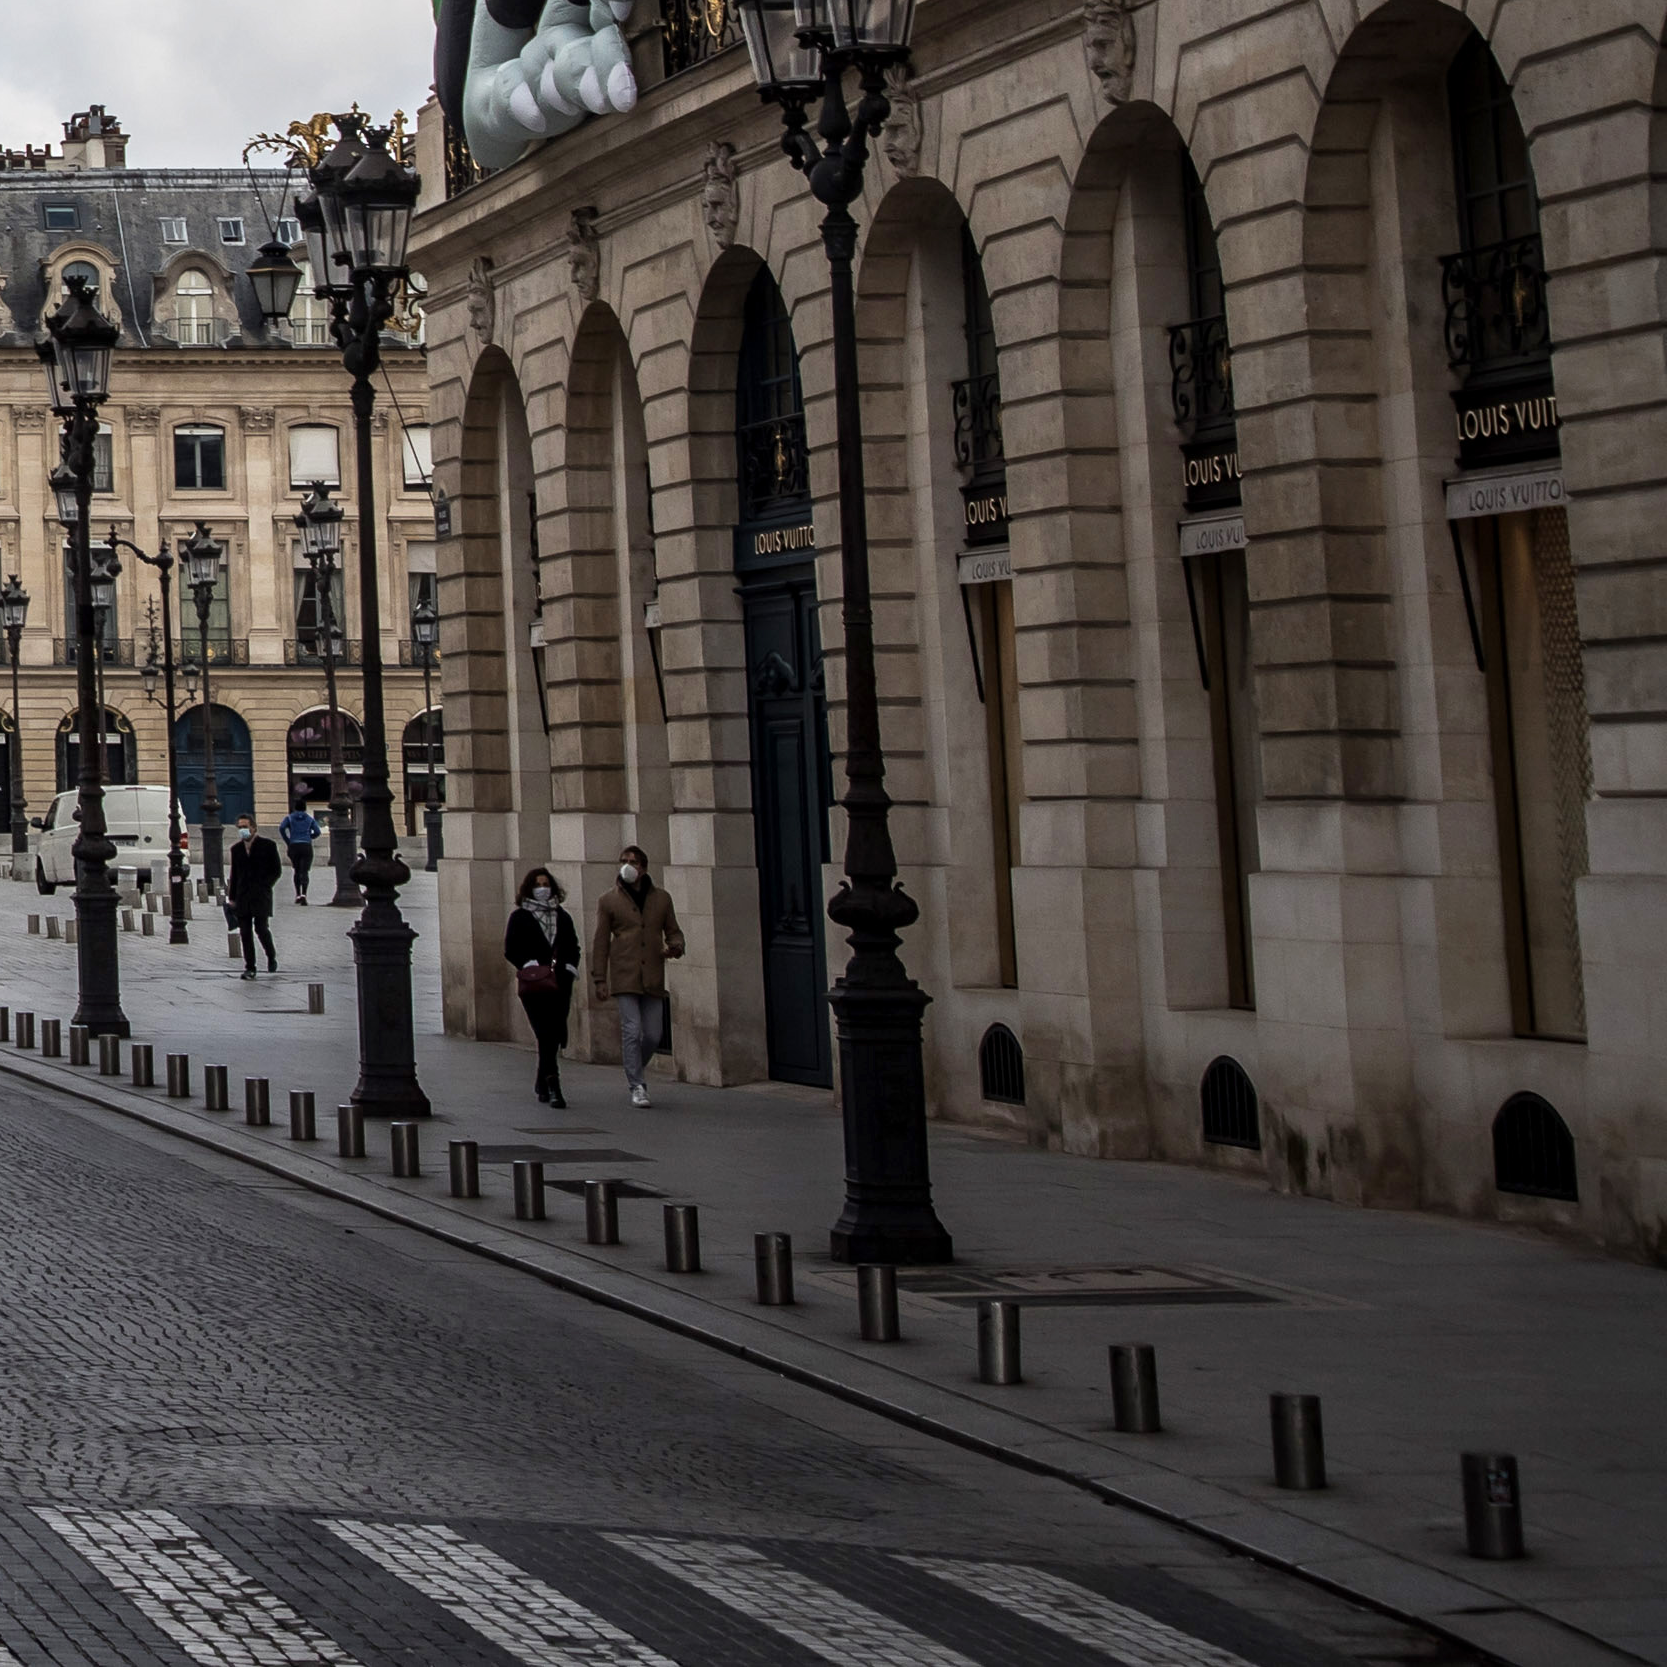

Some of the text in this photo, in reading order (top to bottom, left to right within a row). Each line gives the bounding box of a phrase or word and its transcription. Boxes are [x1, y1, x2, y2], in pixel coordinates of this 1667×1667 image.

[1455, 404, 1510, 441] LOUIS
[1183, 455, 1221, 486] LOUIS
[1469, 479, 1566, 511] LOUIS VUITTO
[963, 497, 997, 525] LOUIS
[754, 530, 782, 555] LOUIS
[1195, 529, 1224, 549] LOUIS
